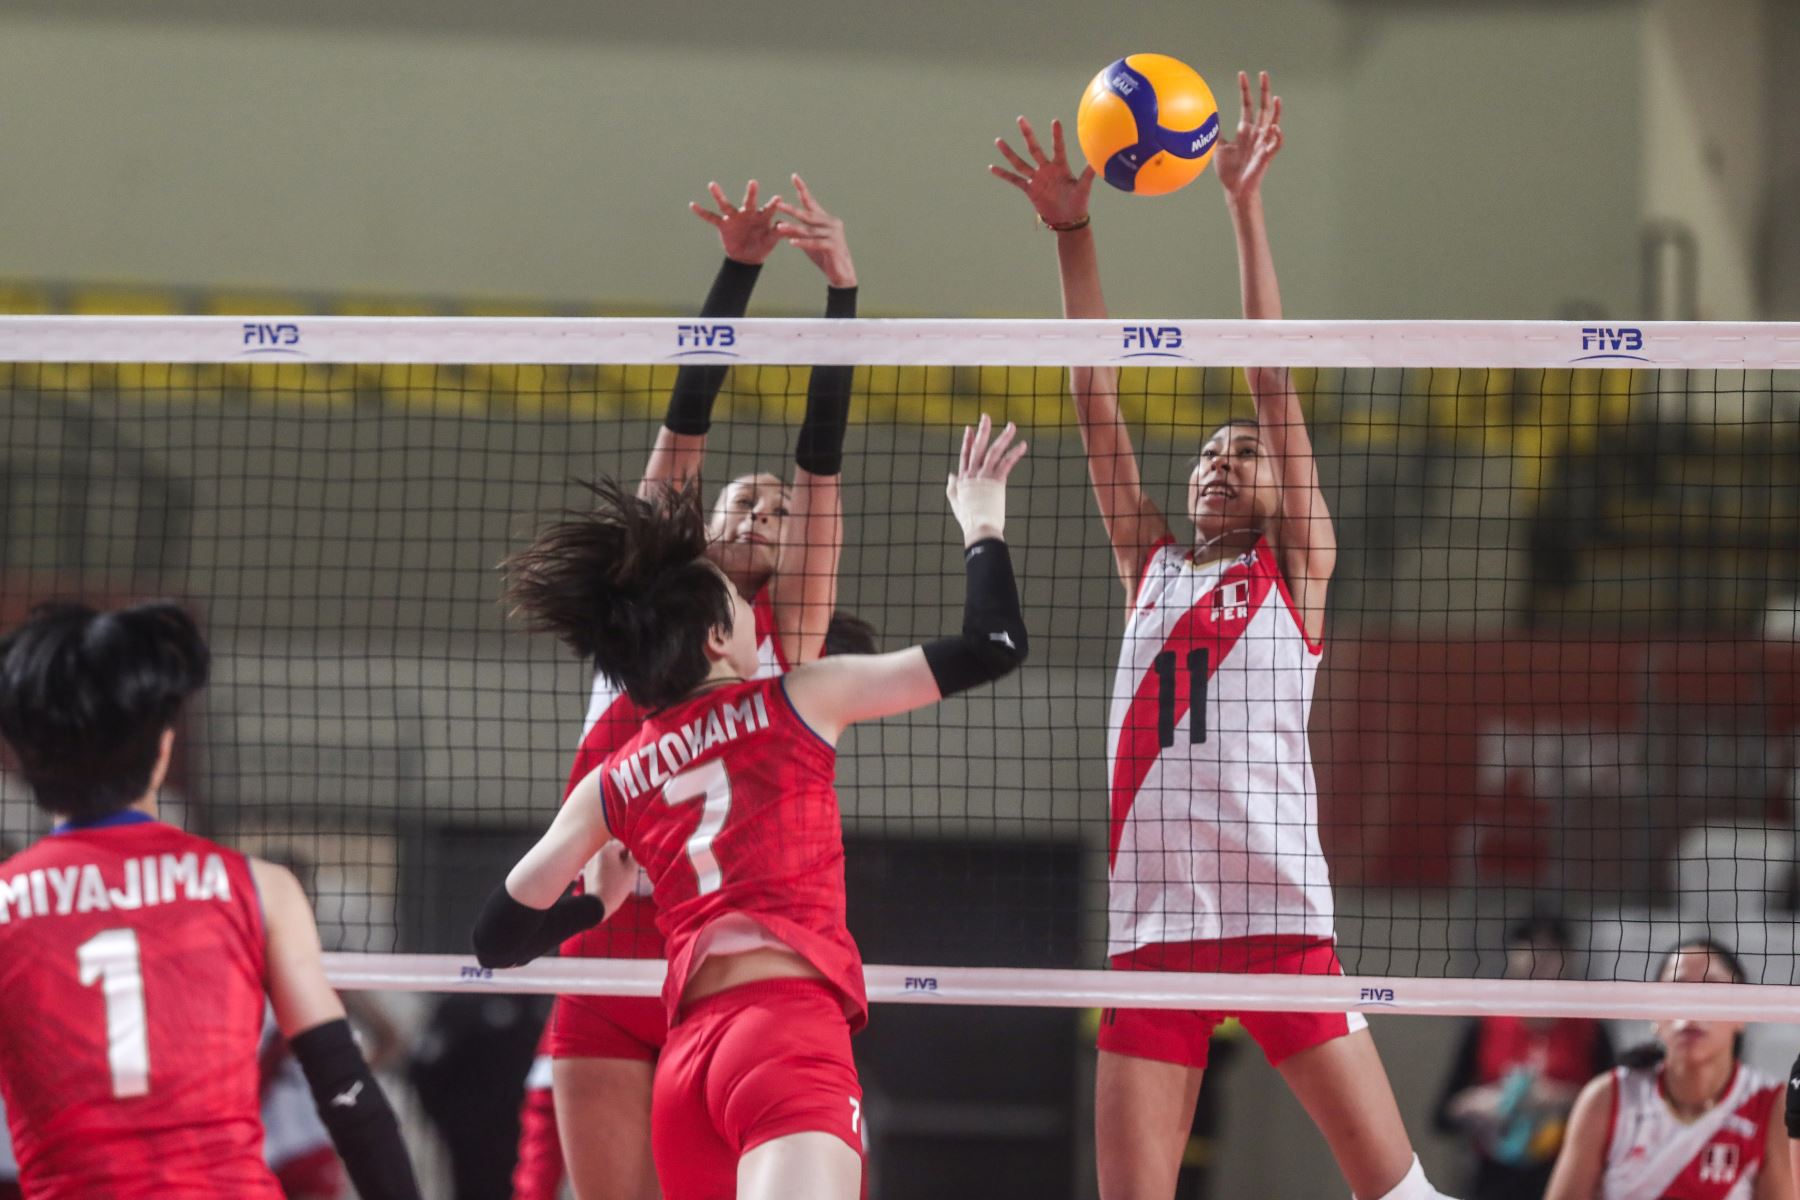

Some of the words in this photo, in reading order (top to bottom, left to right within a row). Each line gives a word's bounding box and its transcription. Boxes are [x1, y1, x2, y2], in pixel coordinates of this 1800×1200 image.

[243, 324, 299, 344] FIVB
[678, 325, 735, 346] FIVB
[1123, 327, 1182, 348] FIVB
[1582, 328, 1643, 350] FIVB
[1210, 606, 1248, 622] PER
[1154, 647, 1209, 748] 11
[608, 692, 770, 806] MIZOKAMI
[662, 757, 733, 896] 7
[0, 851, 232, 924] MIYAJIMA
[461, 966, 494, 979] FIVB
[905, 977, 938, 990] FIVB
[1360, 988, 1394, 1001] FIVB
[77, 927, 150, 1098] 1
[849, 1095, 860, 1134] 7
